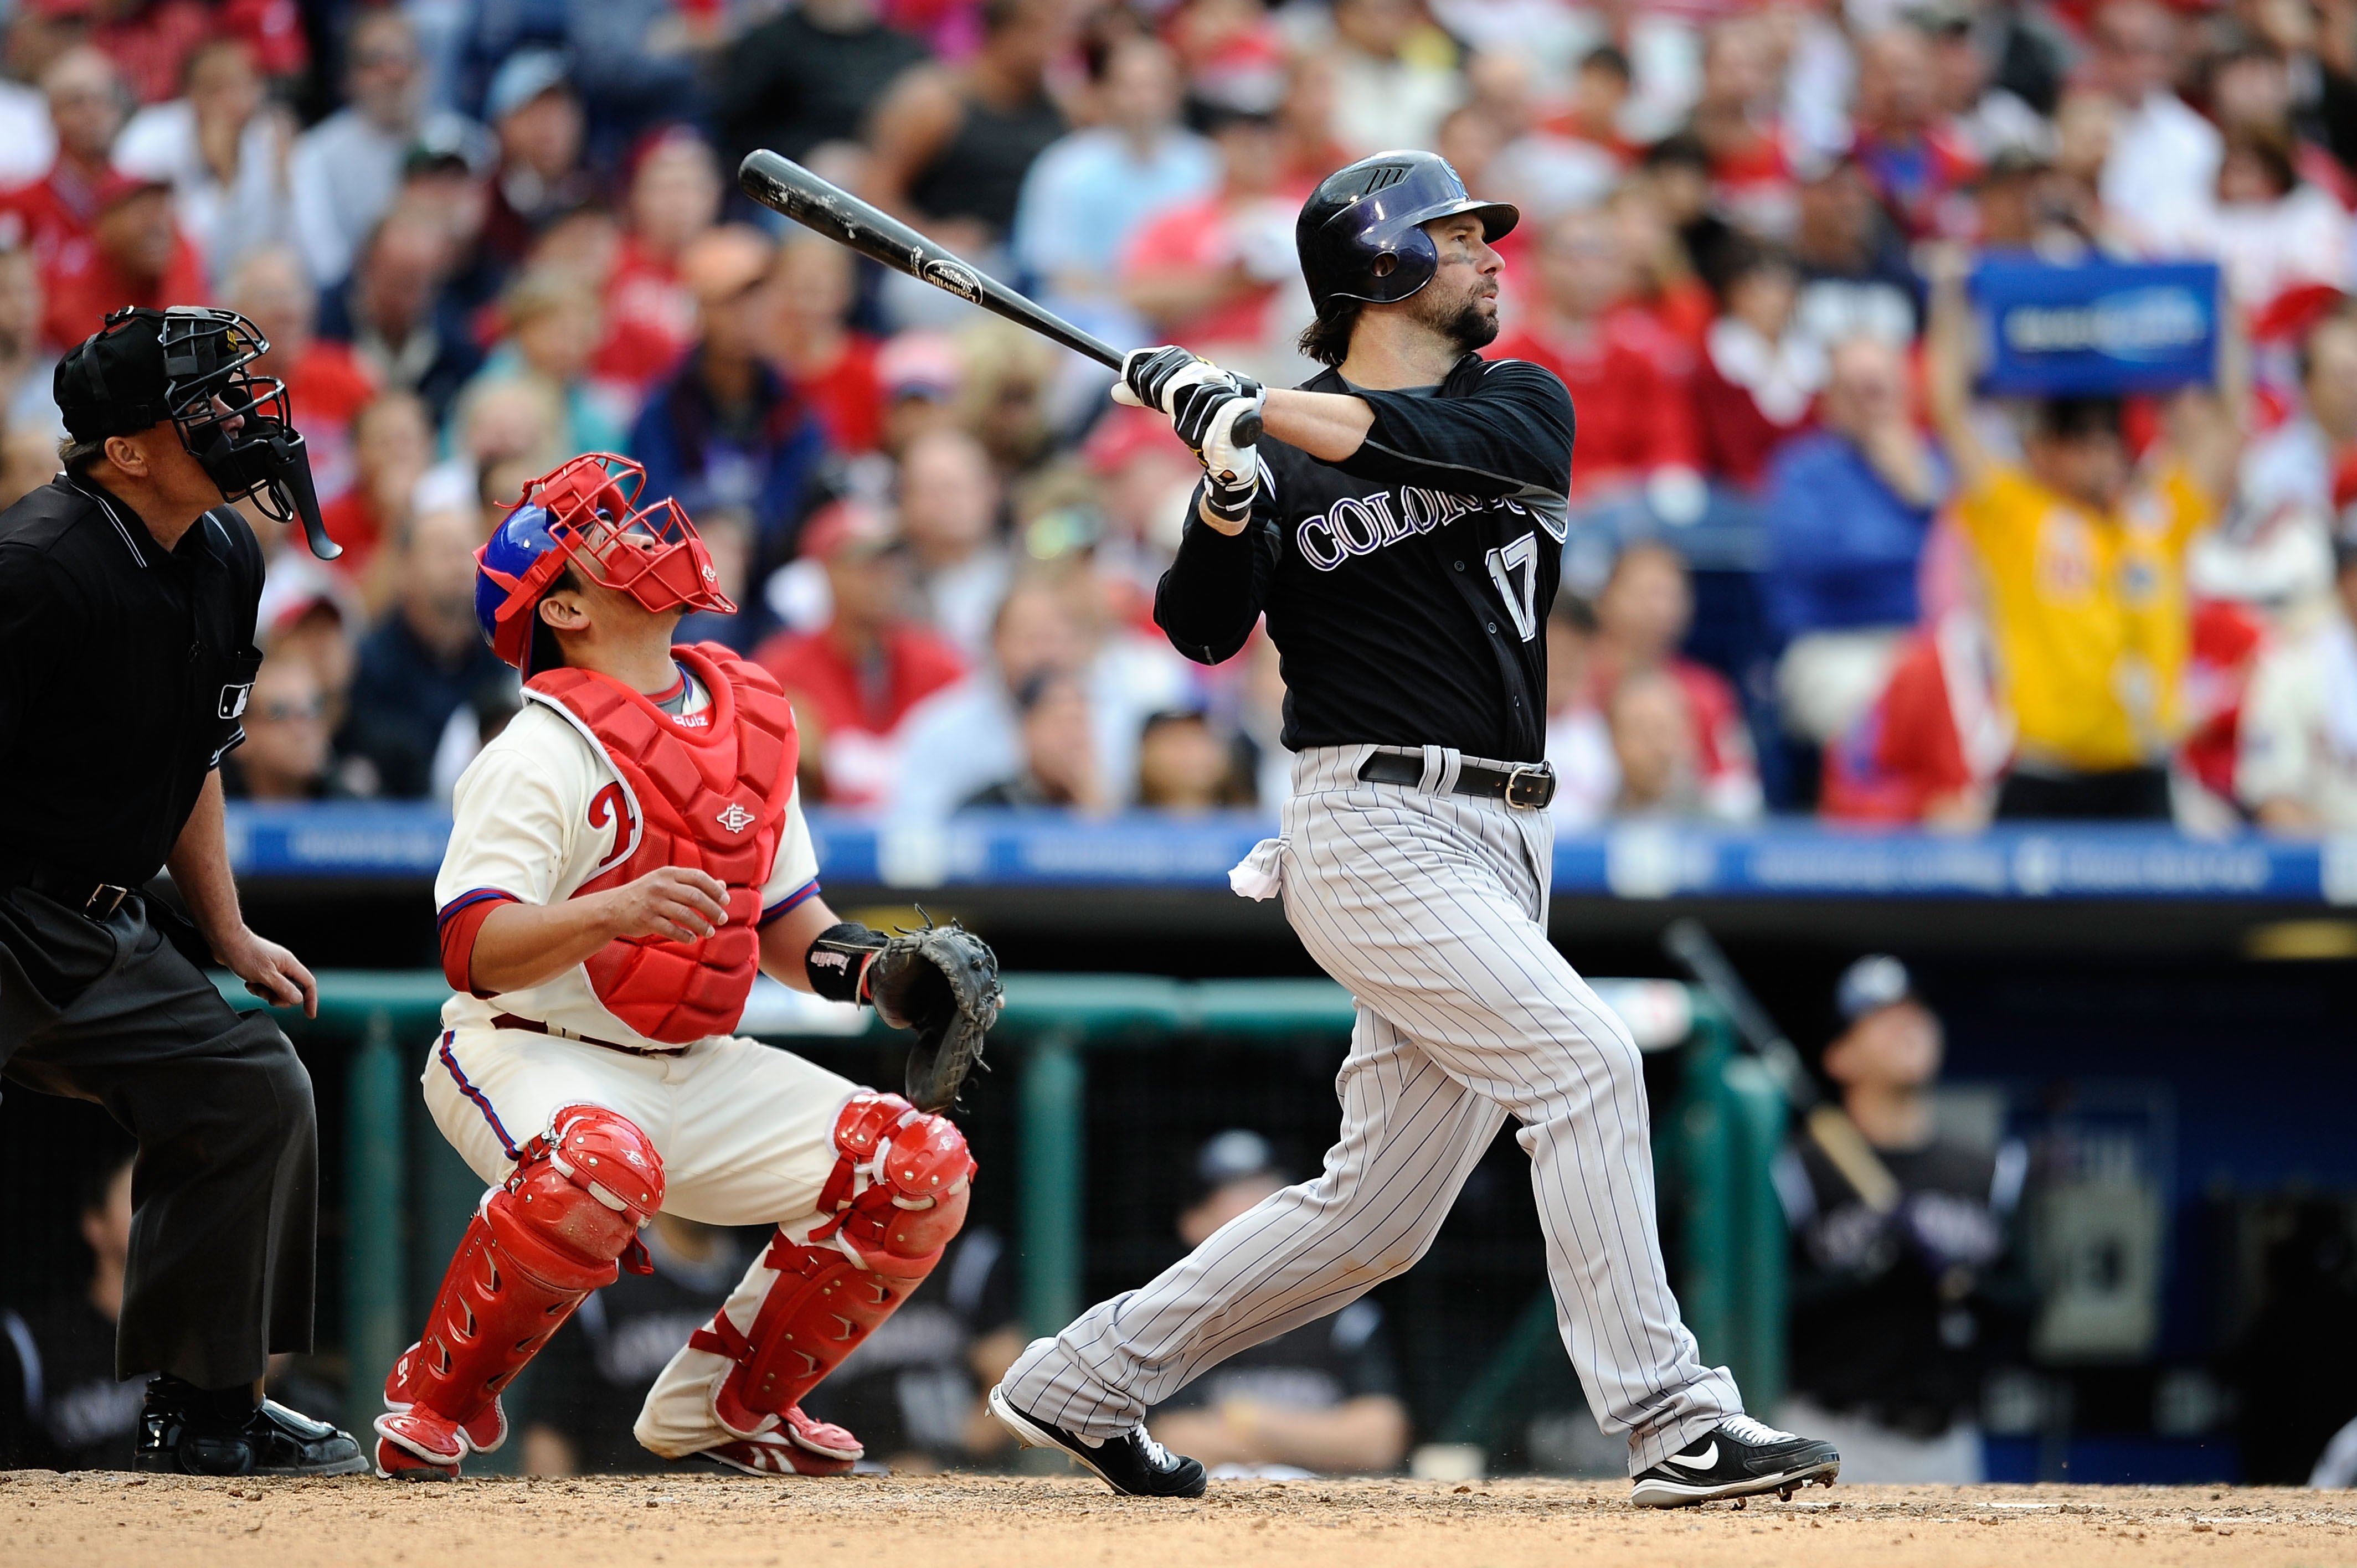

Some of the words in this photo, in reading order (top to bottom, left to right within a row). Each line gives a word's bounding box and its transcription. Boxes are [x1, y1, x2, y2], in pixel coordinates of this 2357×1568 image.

[927, 273, 977, 303] Louisville
[936, 267, 974, 293] Slugger
[1485, 530, 1537, 642] 17
[397, 1356, 409, 1389] 51
